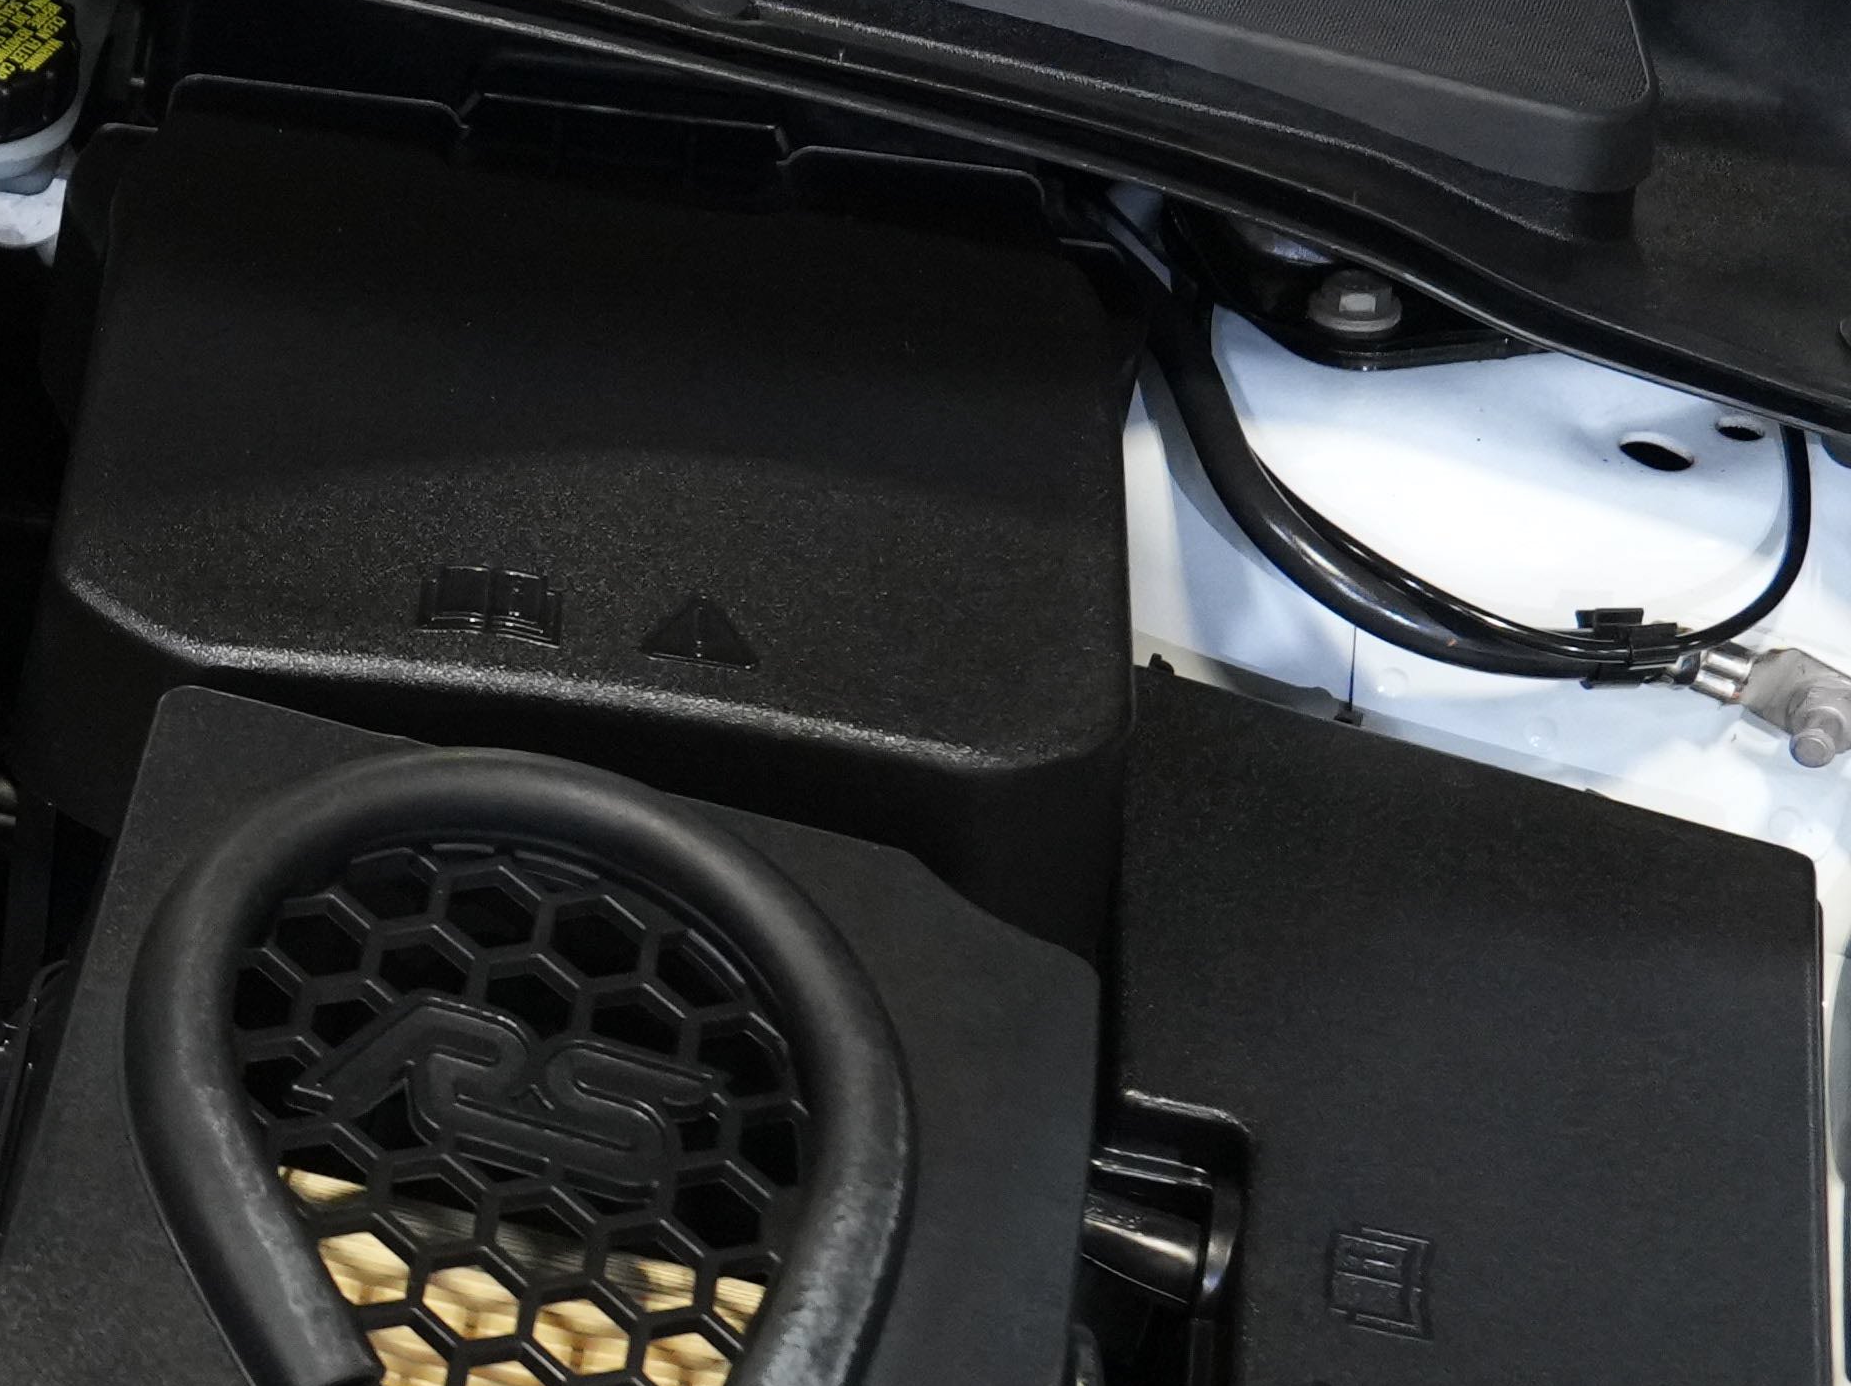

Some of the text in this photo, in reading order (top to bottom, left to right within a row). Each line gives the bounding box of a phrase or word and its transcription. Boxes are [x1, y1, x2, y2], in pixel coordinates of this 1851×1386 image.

[9, 11, 30, 26] DOT
[35, 16, 67, 40] CLEAN
[9, 38, 42, 63] FILLER
